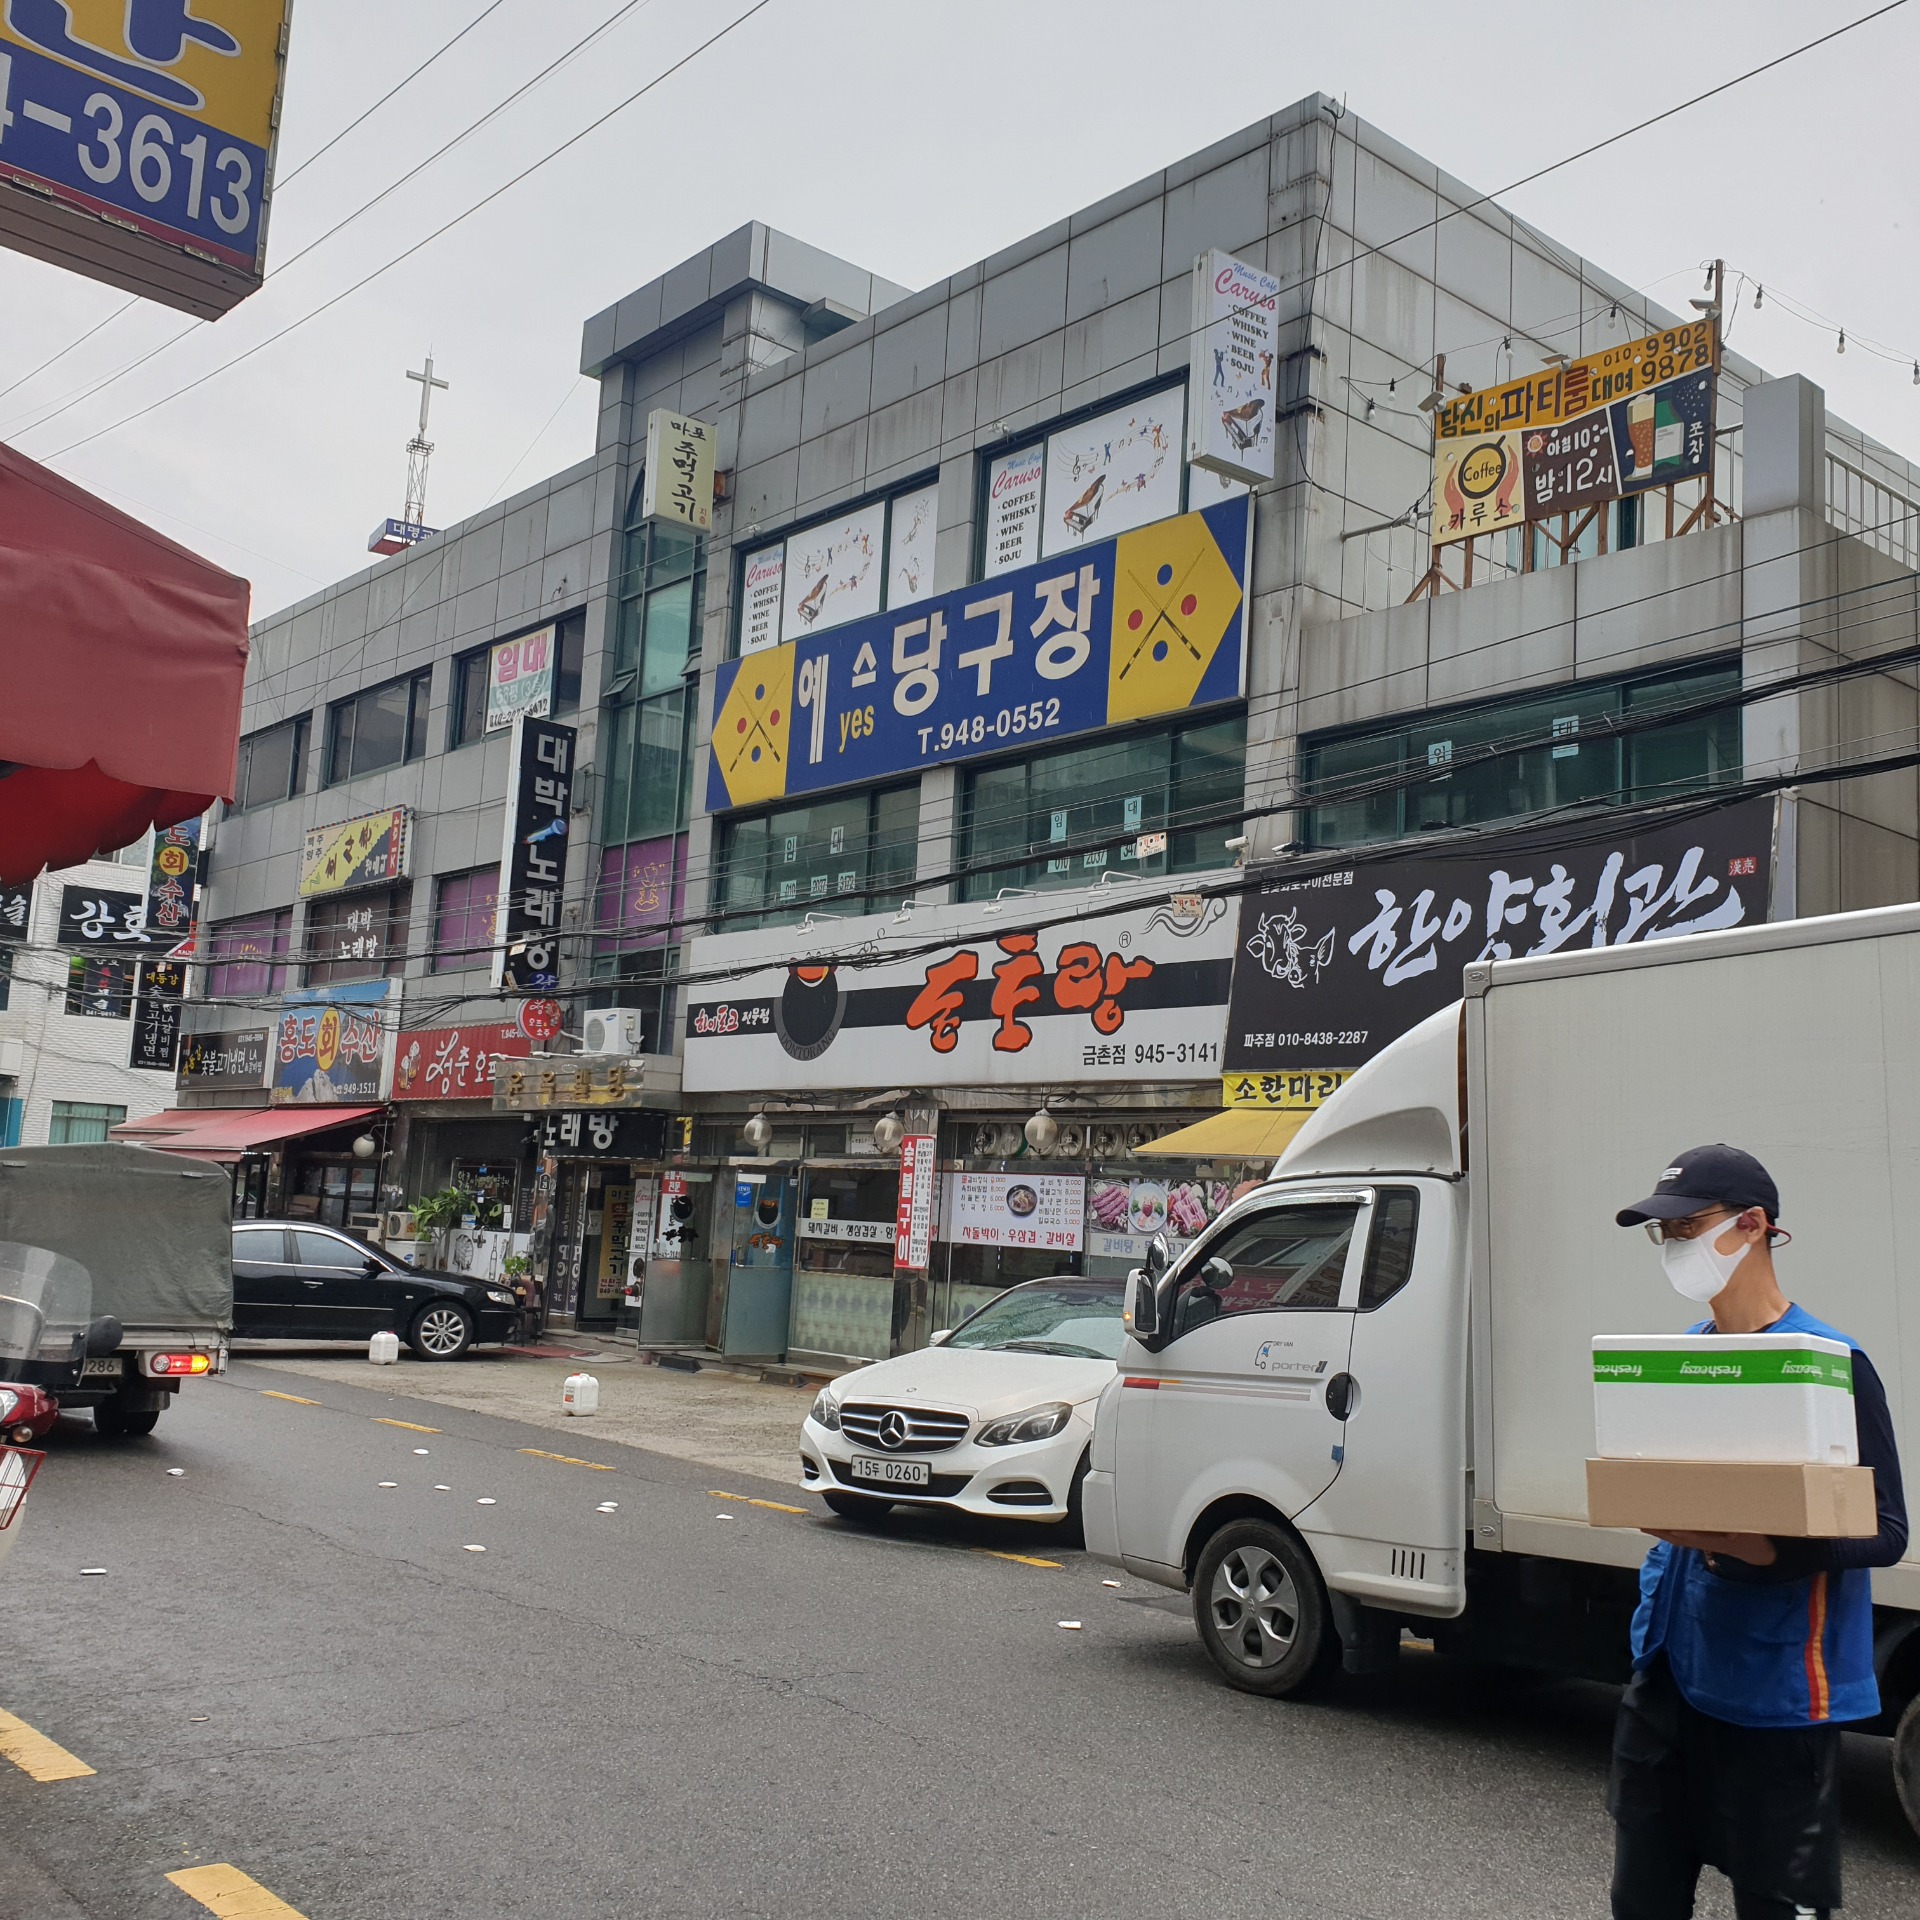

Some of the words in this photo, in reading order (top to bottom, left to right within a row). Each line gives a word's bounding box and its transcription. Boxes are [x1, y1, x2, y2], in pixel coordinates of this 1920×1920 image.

[1233, 262, 1257, 282] Music
[1214, 268, 1277, 311] Caruso
[1232, 304, 1267, 326] COFFEE
[1231, 331, 1257, 348] WINE
[1232, 317, 1269, 340] WHISKY
[1231, 345, 1255, 362] BEER
[1640, 344, 1710, 385] 9878
[1230, 358, 1255, 375] SOJU
[1441, 394, 1500, 437] 당신의
[1500, 365, 1588, 424] 파티룸
[1591, 367, 1633, 402] 대여
[671, 421, 706, 441] 마포
[1546, 434, 1572, 456] 아침
[1689, 421, 1704, 465] 포장
[672, 441, 698, 522] 주먹고기
[992, 466, 1041, 499] Caruso
[1463, 461, 1502, 482] Coffee
[1001, 491, 1036, 510] COFFEE
[1001, 504, 1038, 523] WHISKY
[1449, 498, 1510, 531] 카루소
[1000, 522, 1024, 537] WINE
[999, 536, 1022, 551] BEER
[998, 550, 1022, 565] SOJU
[746, 562, 783, 588] Caruso
[752, 594, 780, 609] WHISKY
[753, 583, 779, 598] COFFEE
[752, 609, 770, 622] WINE
[751, 622, 769, 633] BEER
[750, 633, 768, 645] SOJU
[892, 563, 1100, 717] 당구장
[497, 632, 548, 682] 임대
[839, 705, 874, 753] yes
[917, 697, 1061, 756] T.948-0552
[535, 733, 568, 816] 대박
[523, 844, 558, 970] 노래방
[70, 900, 150, 942] 강호
[347, 907, 374, 933] 대박
[338, 934, 379, 958] 노래방
[146, 973, 179, 987] 대동강
[162, 1015, 174, 1024] LA
[695, 1006, 739, 1033] 하이포크
[741, 1008, 770, 1027] 전문점
[780, 1027, 838, 1061] DONTORANG
[1243, 1031, 1275, 1049] 파주점
[1278, 1029, 1368, 1048] 010-8438-2287
[201, 1048, 245, 1076] 숯불고기냉면
[1082, 1044, 1126, 1066] 금촌점
[1134, 1042, 1219, 1064] 945-3141
[343, 1082, 376, 1095] 949-1511
[1234, 1074, 1344, 1105] 소한마리
[898, 1141, 914, 1261] 숯불구이
[808, 1221, 838, 1235] 돼지갈비
[846, 1224, 877, 1239] 생삼겹살
[1008, 1229, 1036, 1244] 우삼겹
[1046, 1232, 1075, 1247] 갈비살
[1103, 1237, 1134, 1255] 갈비탕
[1680, 1361, 1742, 1377] fresheasy
[885, 1463, 921, 1481] 0260
